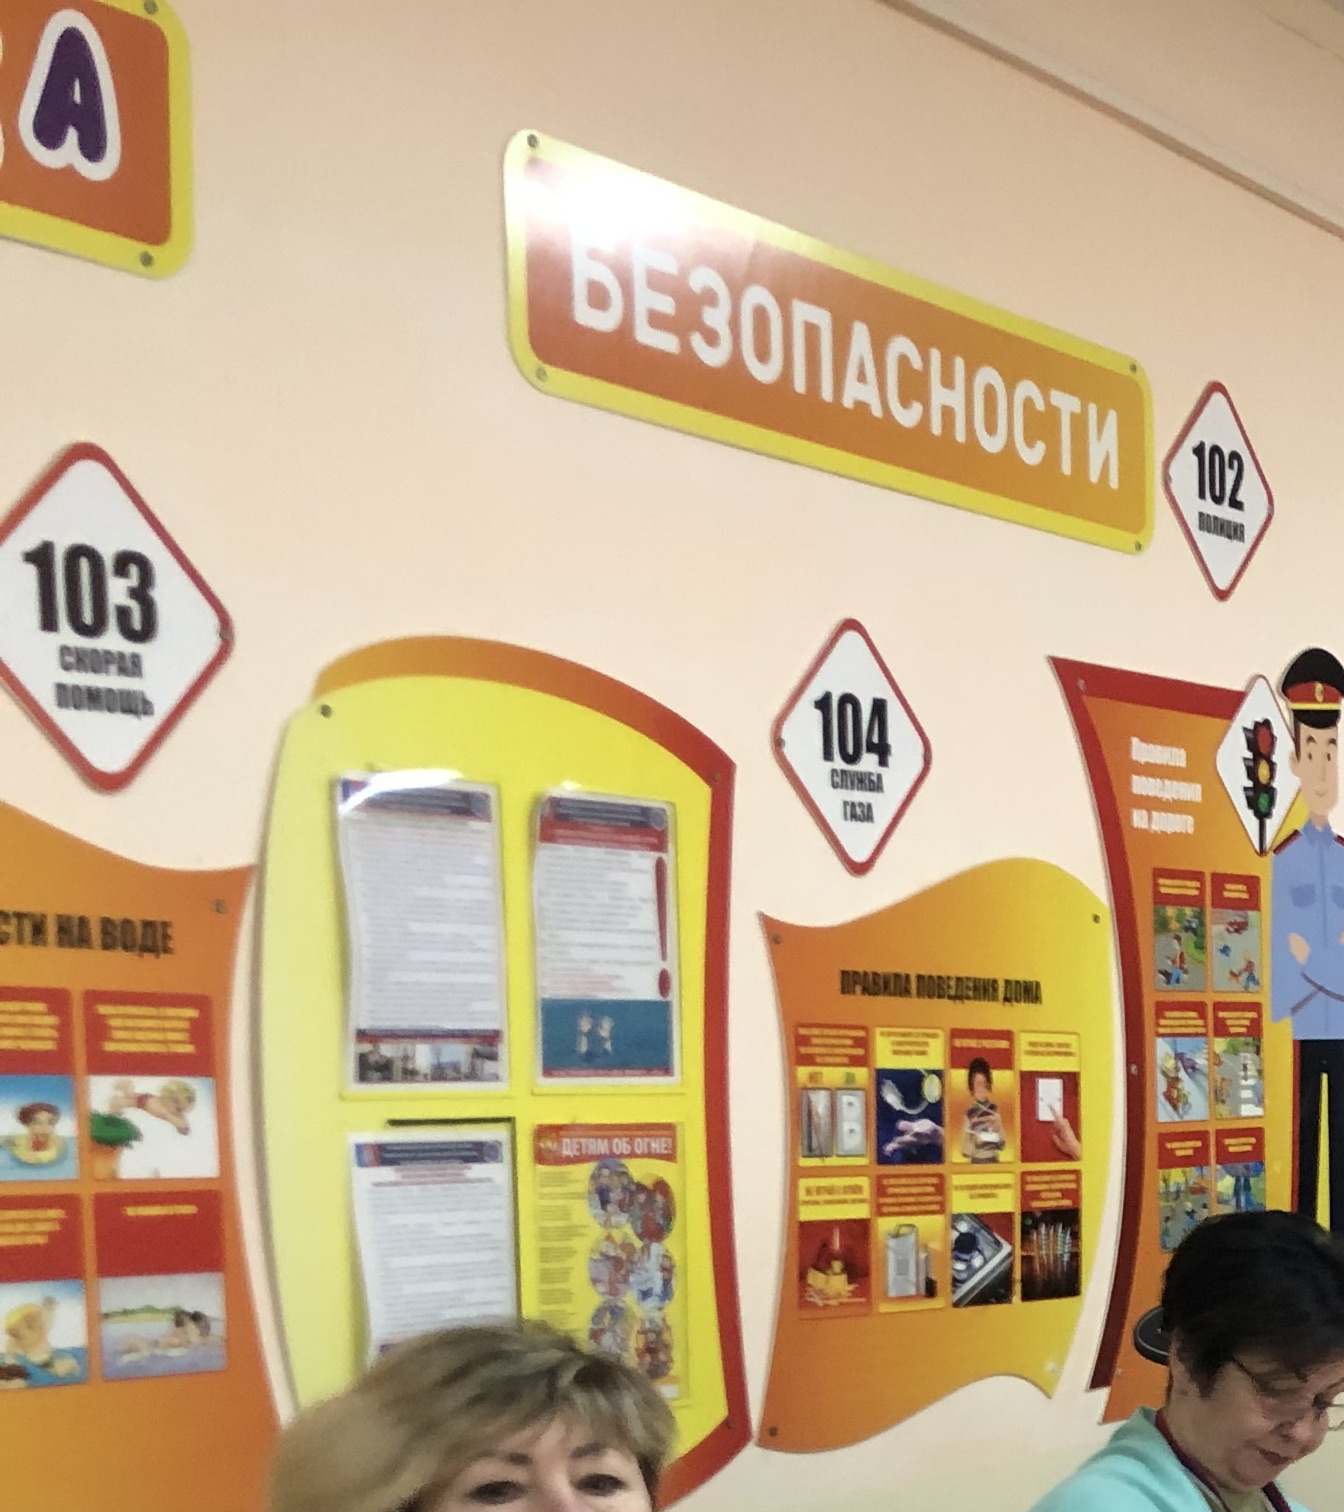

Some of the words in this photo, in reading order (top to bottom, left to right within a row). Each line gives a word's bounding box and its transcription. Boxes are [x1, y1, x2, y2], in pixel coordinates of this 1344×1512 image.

[0, 9, 121, 181] А
[570, 228, 1119, 490] БЕЗОПАСНОСТИ
[1192, 440, 1245, 512] 102
[1198, 511, 1246, 543] ПОЛИЦИЯ
[22, 540, 158, 644] 103
[58, 645, 143, 678] СКОРАЯ
[54, 682, 155, 720] ПОМОЩЬ
[814, 691, 892, 768] 104
[1131, 736, 1187, 768] Правила
[830, 768, 885, 794] СЛУЖБА
[842, 800, 875, 823] ГАЗА
[56, 912, 94, 950] НА
[99, 916, 174, 959] ВОДЕ
[840, 969, 912, 998] ПРАВИЛА
[915, 973, 999, 1004] ПОВЕДЕНИЯ
[1002, 979, 1042, 1007] ДОМА
[562, 1138, 609, 1158] ДЕТЯМ
[613, 1138, 631, 1154] ОБ
